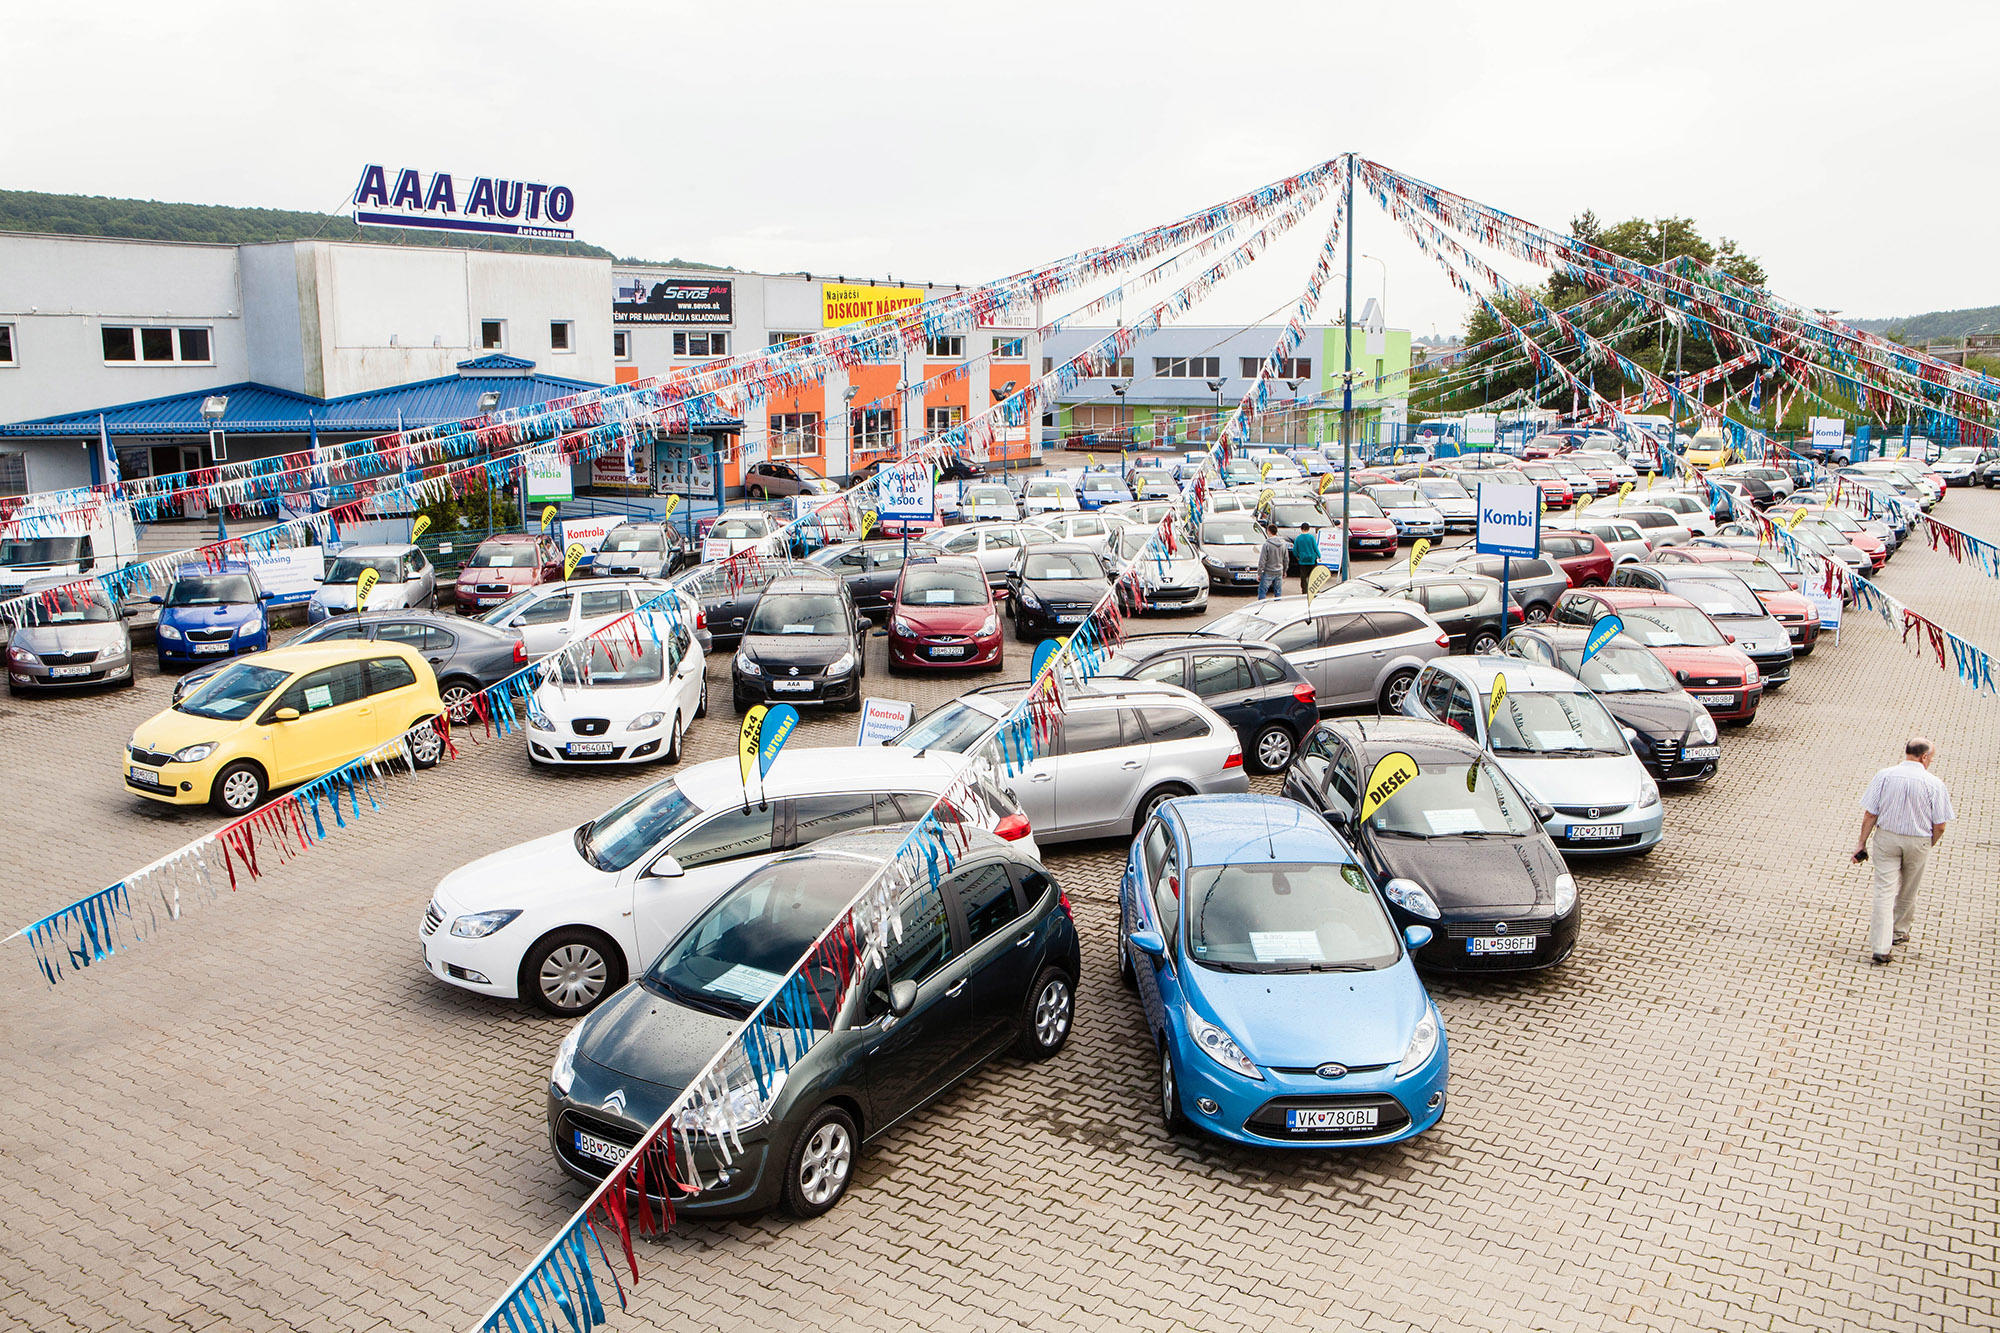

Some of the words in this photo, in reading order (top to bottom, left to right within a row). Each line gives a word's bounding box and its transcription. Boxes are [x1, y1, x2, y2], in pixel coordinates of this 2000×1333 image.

[353, 164, 457, 212] AAA
[464, 176, 575, 223] AUTO
[517, 226, 573, 239] Autocentrum
[663, 286, 710, 299] SEVOS
[709, 285, 728, 295] plus
[826, 290, 860, 301] Najväčší
[629, 312, 642, 321] PRE
[643, 311, 685, 322] MANIPULÁCIU
[685, 313, 691, 321] A
[827, 301, 873, 320] DISKONT
[1815, 429, 1842, 437] Kombi
[534, 470, 562, 478] Fabia
[897, 485, 916, 493] nad
[1483, 508, 1533, 527] Kombi
[1790, 512, 1805, 528] DIESEL
[414, 520, 429, 536] DIESEL
[567, 527, 605, 540] Kontrola
[263, 555, 291, 565] leasing
[1412, 545, 1428, 566] DIESEL
[359, 575, 376, 600] DIESEL
[1309, 571, 1329, 593] DIESEL
[1588, 624, 1619, 653] AUTOMAT
[1491, 686, 1505, 714] DIESEL
[869, 707, 905, 721] Kontrola
[743, 714, 758, 739] 4x4
[866, 720, 904, 732] najazdených
[763, 714, 795, 760] AUTOMAT
[1369, 768, 1412, 806] DIESEL
